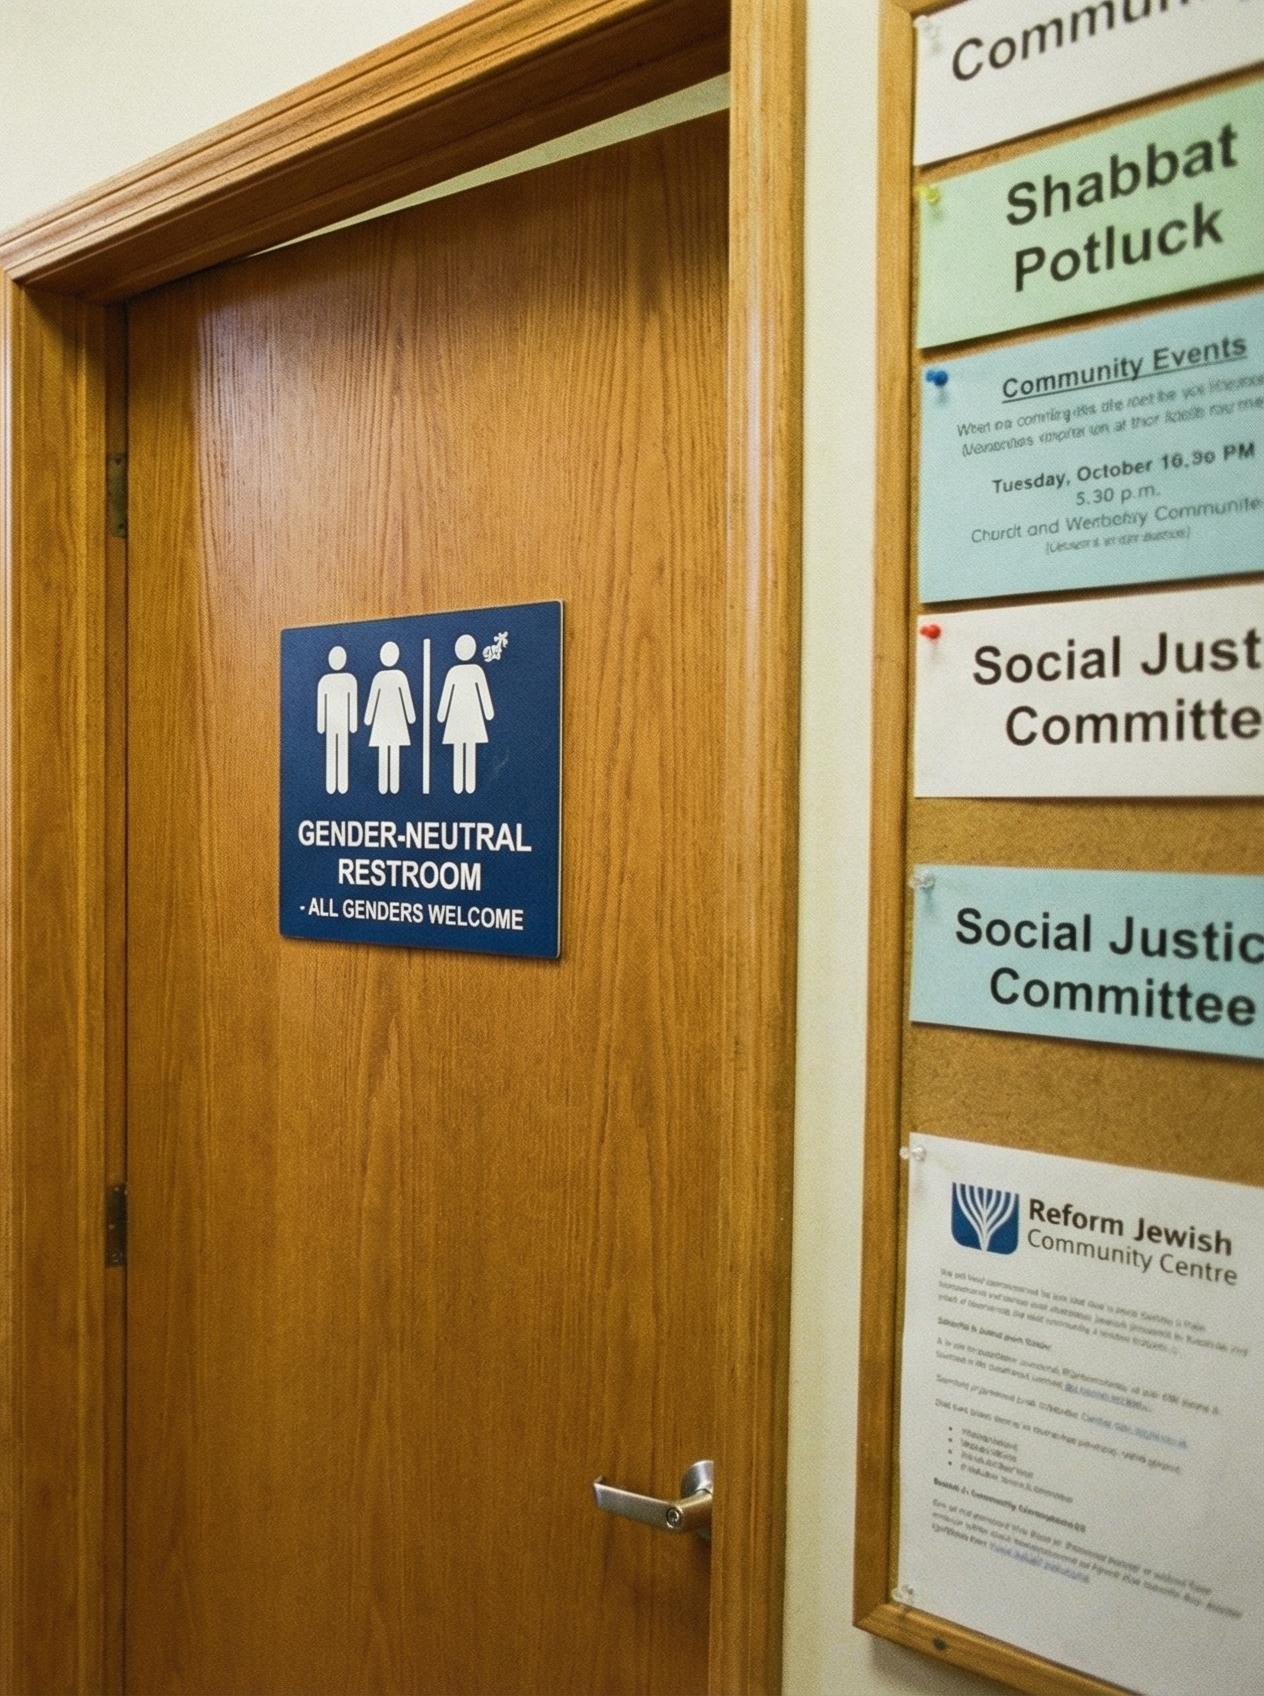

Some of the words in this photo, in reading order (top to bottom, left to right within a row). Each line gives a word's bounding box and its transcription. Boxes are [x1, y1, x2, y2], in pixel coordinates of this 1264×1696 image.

[1006, 123, 1238, 226] Shabbat
[1015, 202, 1225, 292] Potluck
[1002, 357, 1144, 399] Community
[1152, 336, 1247, 371] Events
[992, 472, 1071, 493] Tuesday,
[1076, 459, 1153, 482] October
[1223, 441, 1255, 461] PM
[1076, 487, 1115, 506] 5.30
[1026, 519, 1060, 537] and
[973, 635, 1121, 686] Social
[1140, 628, 1262, 677] Just
[1005, 697, 1263, 747] Committe
[298, 820, 532, 852] GENDER-NEUTRAL
[338, 858, 481, 891] RESTROOM
[308, 897, 339, 918] ALL
[342, 898, 424, 924] GENDERS
[427, 904, 524, 931] WELCOME
[955, 907, 1092, 953] Social
[1109, 915, 1264, 965] Justic
[990, 966, 1257, 1027] Committee
[1029, 1198, 1125, 1237] Reform
[1133, 1217, 1233, 1257] Jewish
[1027, 1228, 1153, 1274] Community
[1159, 1253, 1238, 1286] Centre
